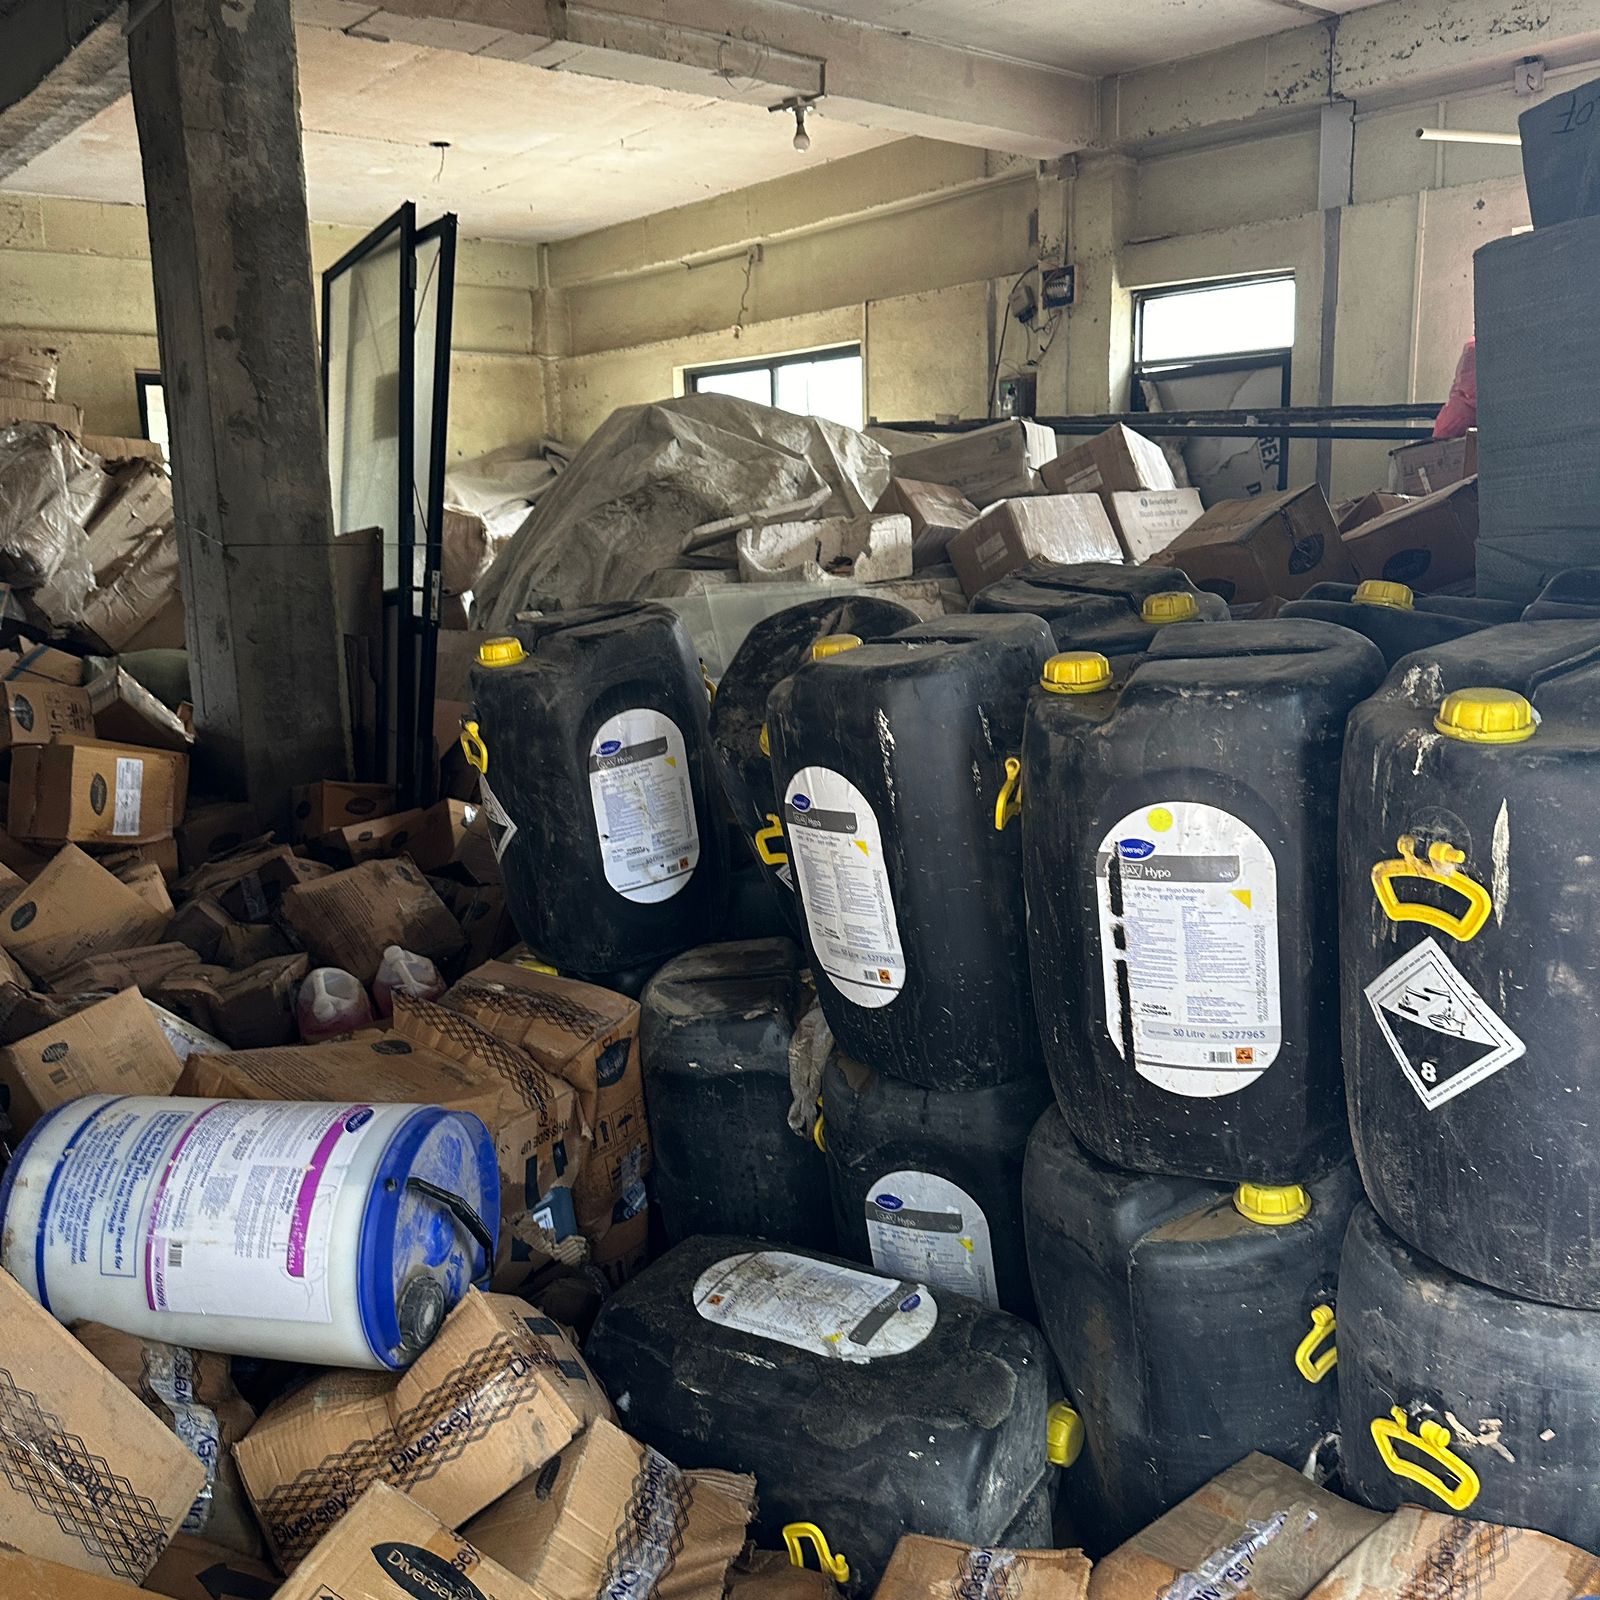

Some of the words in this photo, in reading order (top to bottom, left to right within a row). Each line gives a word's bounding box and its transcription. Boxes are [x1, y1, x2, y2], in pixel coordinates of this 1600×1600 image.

[1145, 867, 1172, 879] Hypo
[1173, 1028, 1185, 1037] 50
[1186, 1029, 1206, 1039] Litre
[1420, 1061, 1437, 1083] 8
[139, 1131, 162, 1165] Technical
[119, 1167, 142, 1223] Information
[82, 1196, 97, 1227] Private
[79, 1229, 89, 1263] Limited
[114, 1226, 127, 1254] Sheet
[114, 1255, 124, 1269] for
[388, 1403, 473, 1474] Diversey
